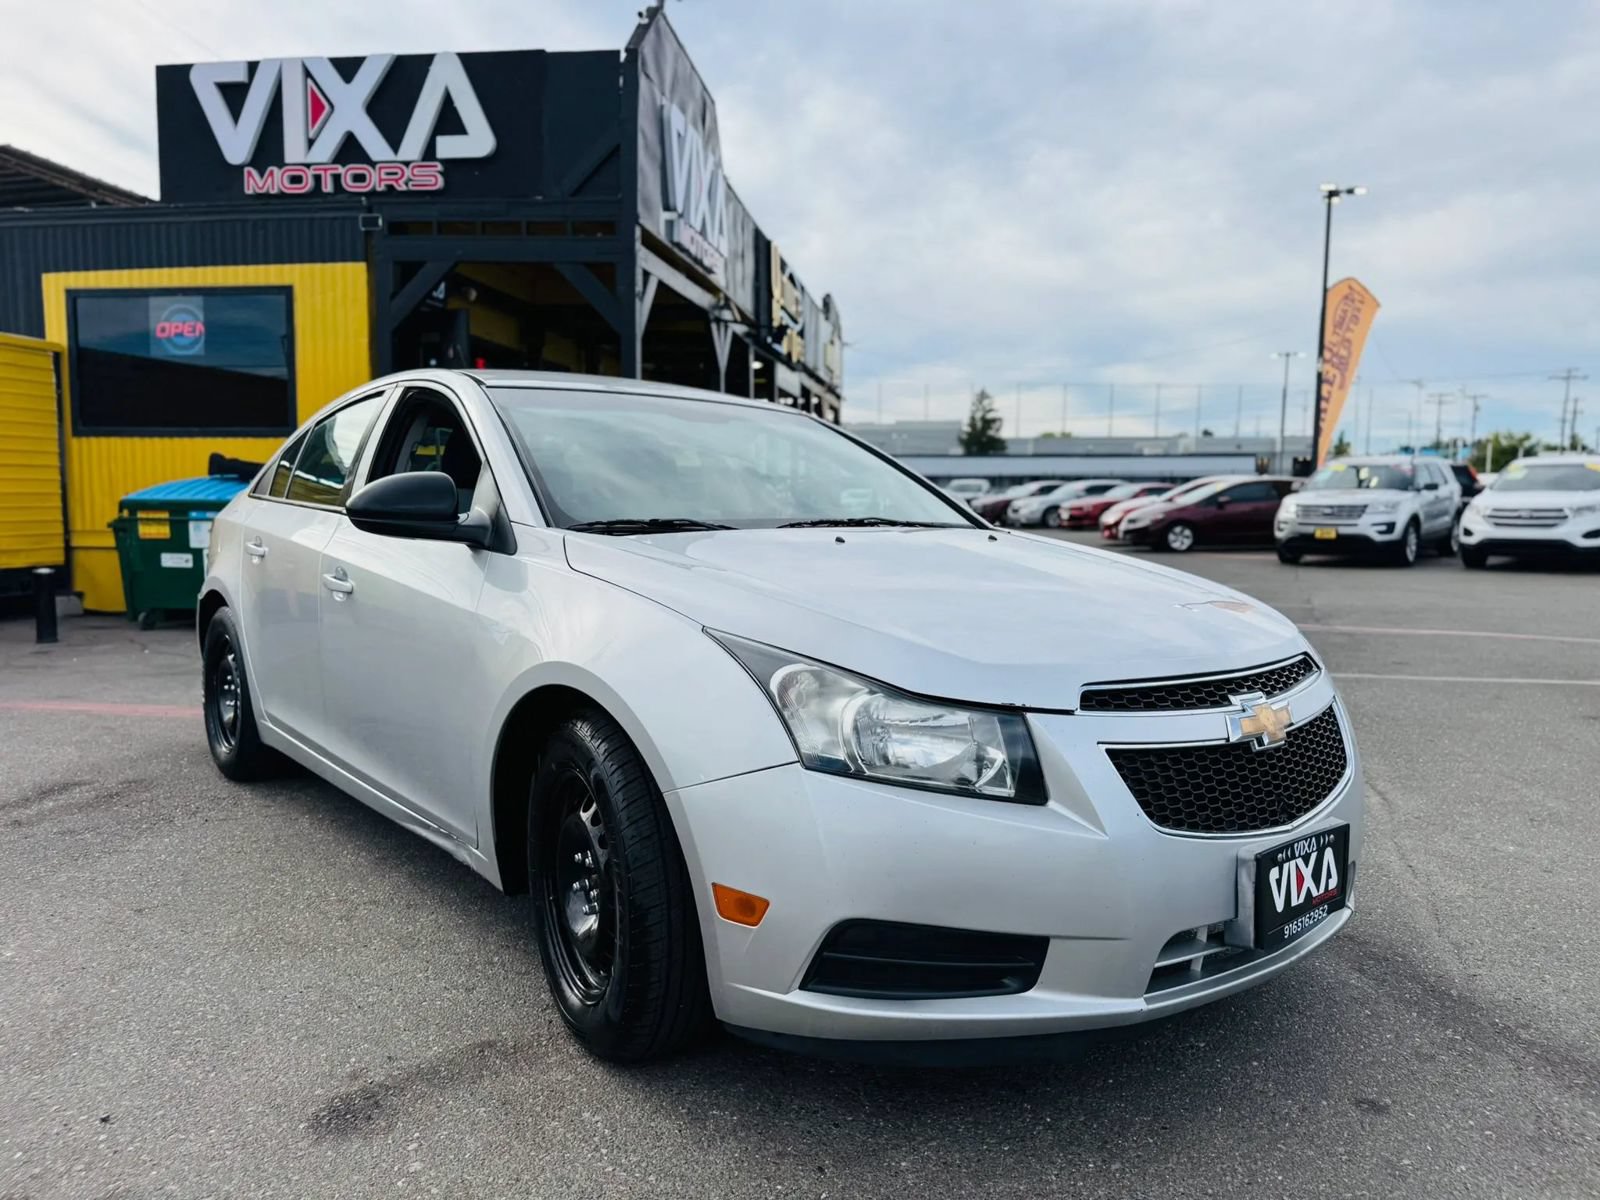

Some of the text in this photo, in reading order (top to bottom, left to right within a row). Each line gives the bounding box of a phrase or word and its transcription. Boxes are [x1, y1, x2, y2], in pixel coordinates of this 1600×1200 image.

[190, 51, 497, 165] VIXA
[244, 162, 444, 194] MOTORS
[155, 320, 205, 338] OPEN
[1294, 836, 1317, 857] VIXA
[1269, 846, 1338, 913] VIXA
[1284, 904, 1328, 939] 9165162952
